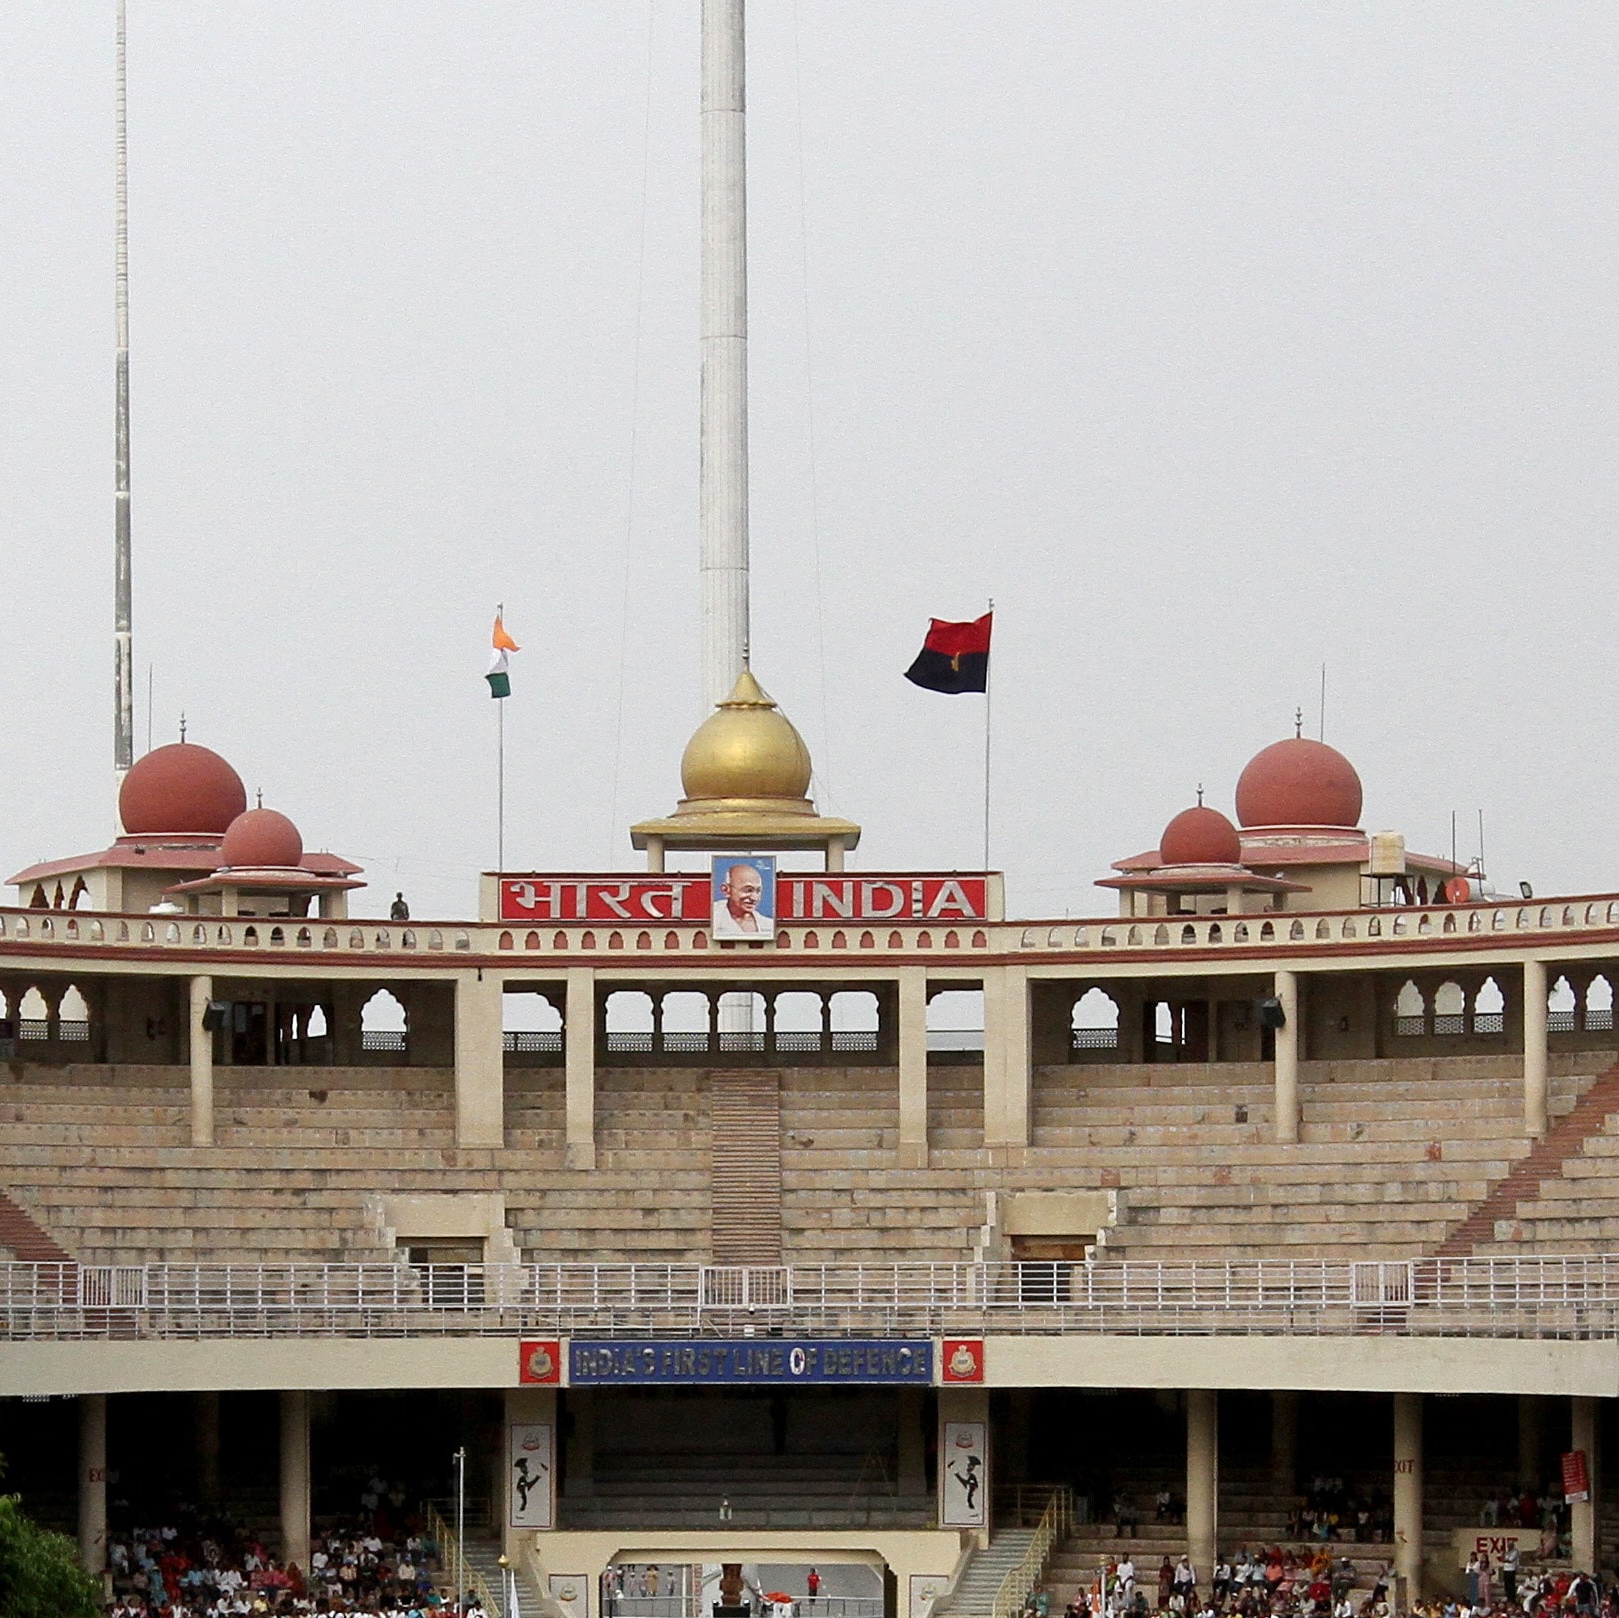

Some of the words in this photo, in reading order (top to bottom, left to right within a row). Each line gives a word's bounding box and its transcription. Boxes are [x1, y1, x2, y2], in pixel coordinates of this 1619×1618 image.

[510, 881, 692, 919] भारत
[792, 881, 977, 918] INDIA
[575, 1348, 655, 1376] INDIA'S
[661, 1348, 728, 1375] FIRST
[733, 1348, 783, 1375] LINE
[789, 1347, 818, 1376] OF
[823, 1347, 927, 1376] DEFENCE
